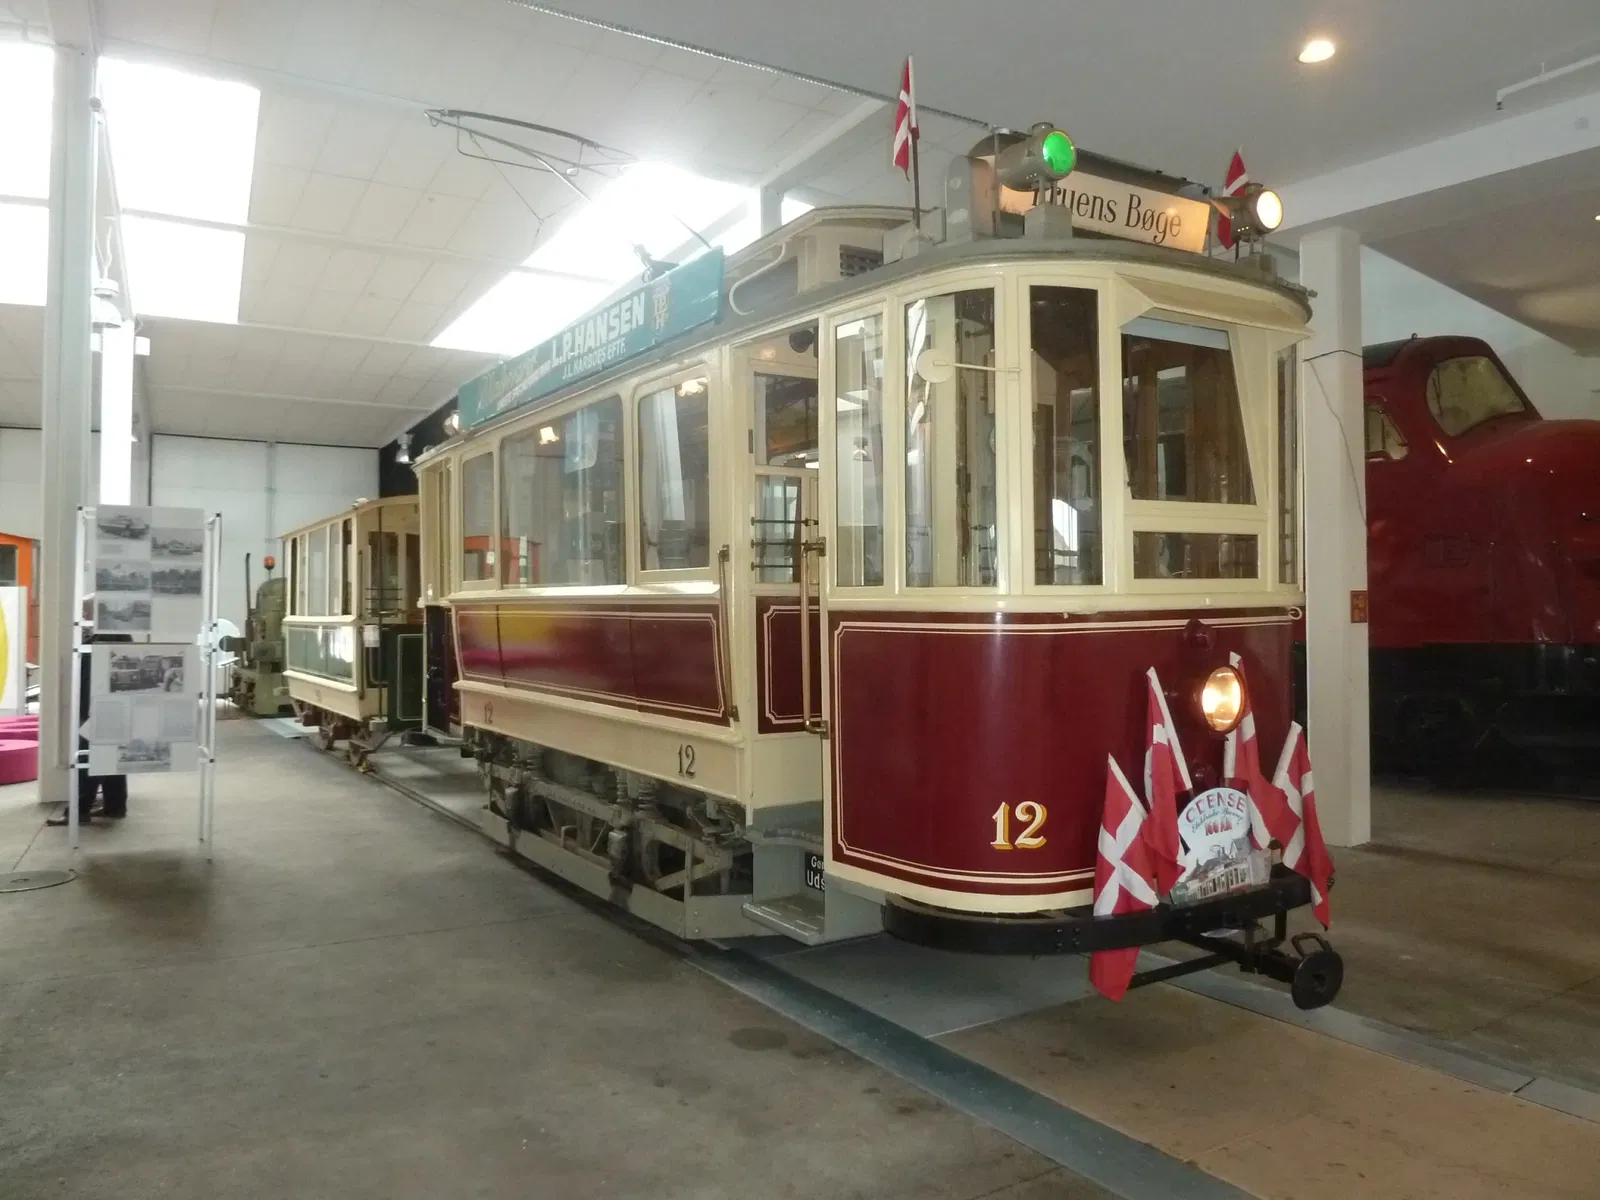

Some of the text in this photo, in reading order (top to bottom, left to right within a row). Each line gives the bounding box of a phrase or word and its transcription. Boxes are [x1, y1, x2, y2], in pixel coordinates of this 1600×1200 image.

[1125, 194, 1181, 243] Bøge
[484, 701, 493, 724] 12
[677, 743, 696, 777] 12
[990, 801, 1048, 850] 12
